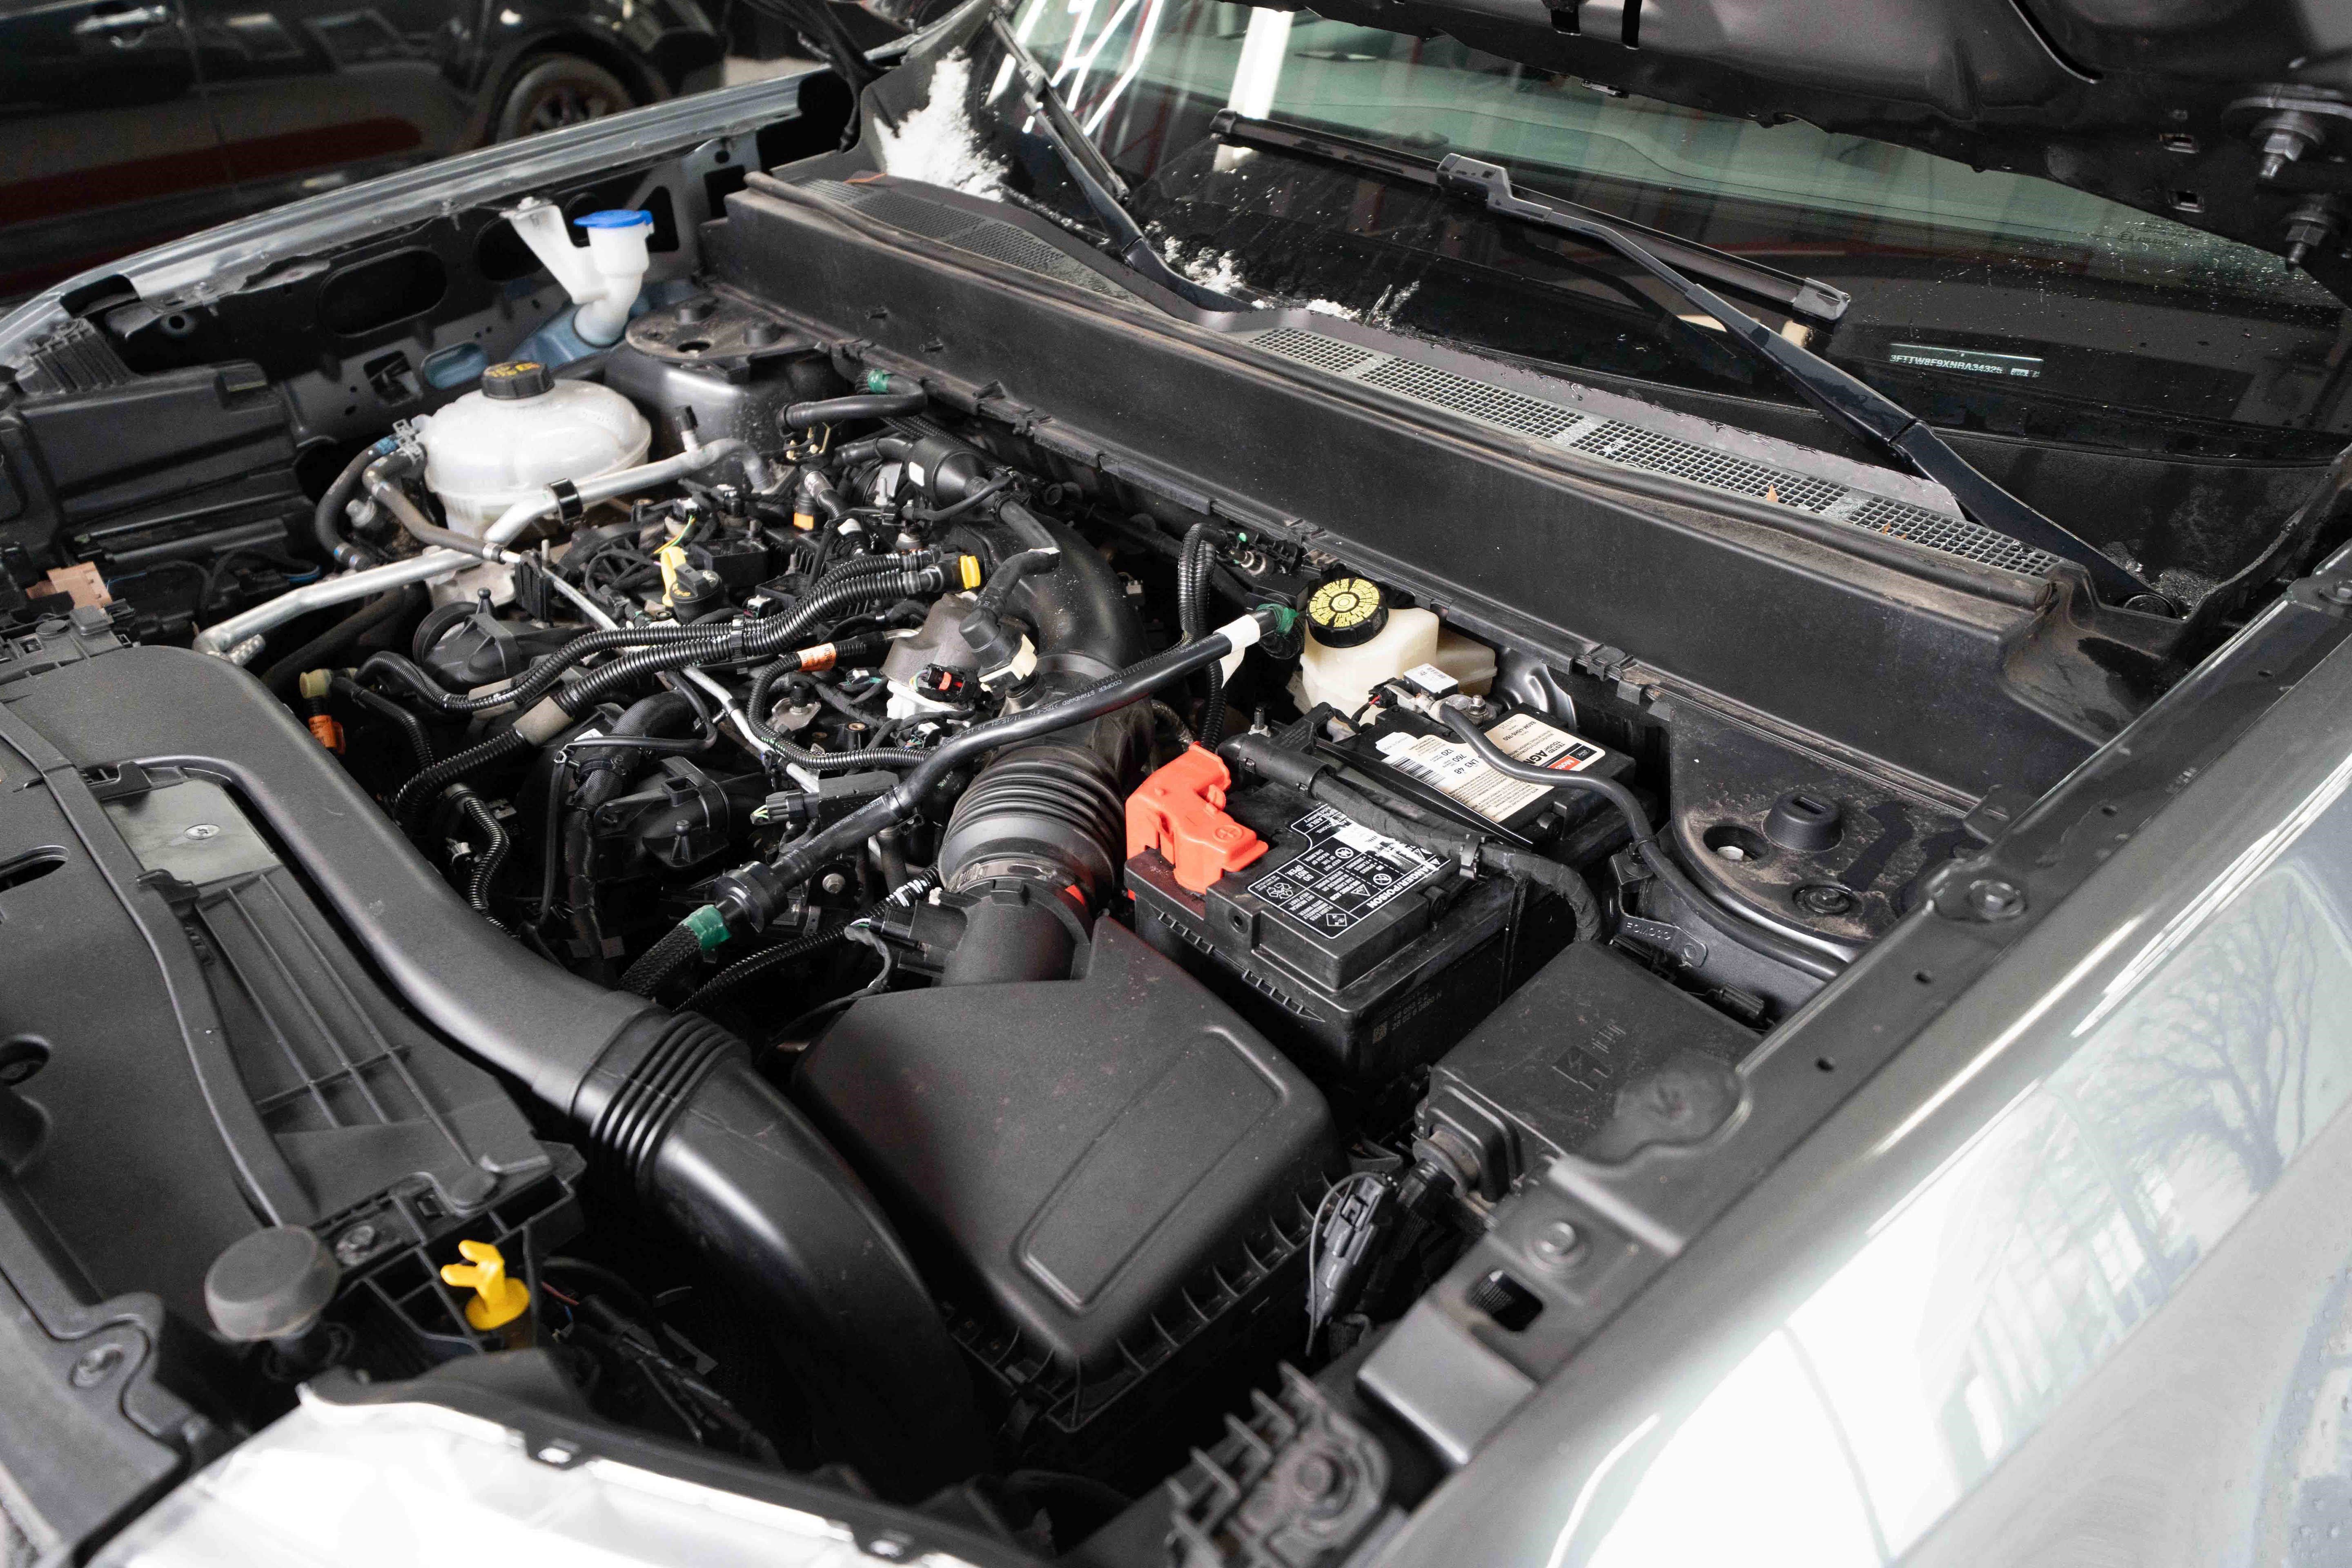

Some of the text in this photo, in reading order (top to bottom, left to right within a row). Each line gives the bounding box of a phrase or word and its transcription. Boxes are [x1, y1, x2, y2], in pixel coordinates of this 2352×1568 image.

[1097, 678, 1123, 692] COOPER
[1061, 689, 1096, 706] STANDARD
[1440, 747, 1454, 756] 120
[1547, 742, 1566, 754] TESTED
[1451, 753, 1467, 763] 760
[1554, 758, 1575, 771] Moto
[1453, 758, 1479, 775] LN3 48
[856, 799, 882, 815] STANDARD
[1302, 811, 1322, 824] Battery
[1303, 848, 1324, 862] CHILDREN.
[1315, 852, 1330, 862] REACH
[1330, 858, 1342, 866] KEEP
[1353, 860, 1370, 871] FLAMES
[1284, 864, 1304, 878] OPEN.
[1294, 869, 1309, 879] NOT
[1302, 873, 1314, 882] DO
[1365, 864, 1430, 909] ANGER/POISON
